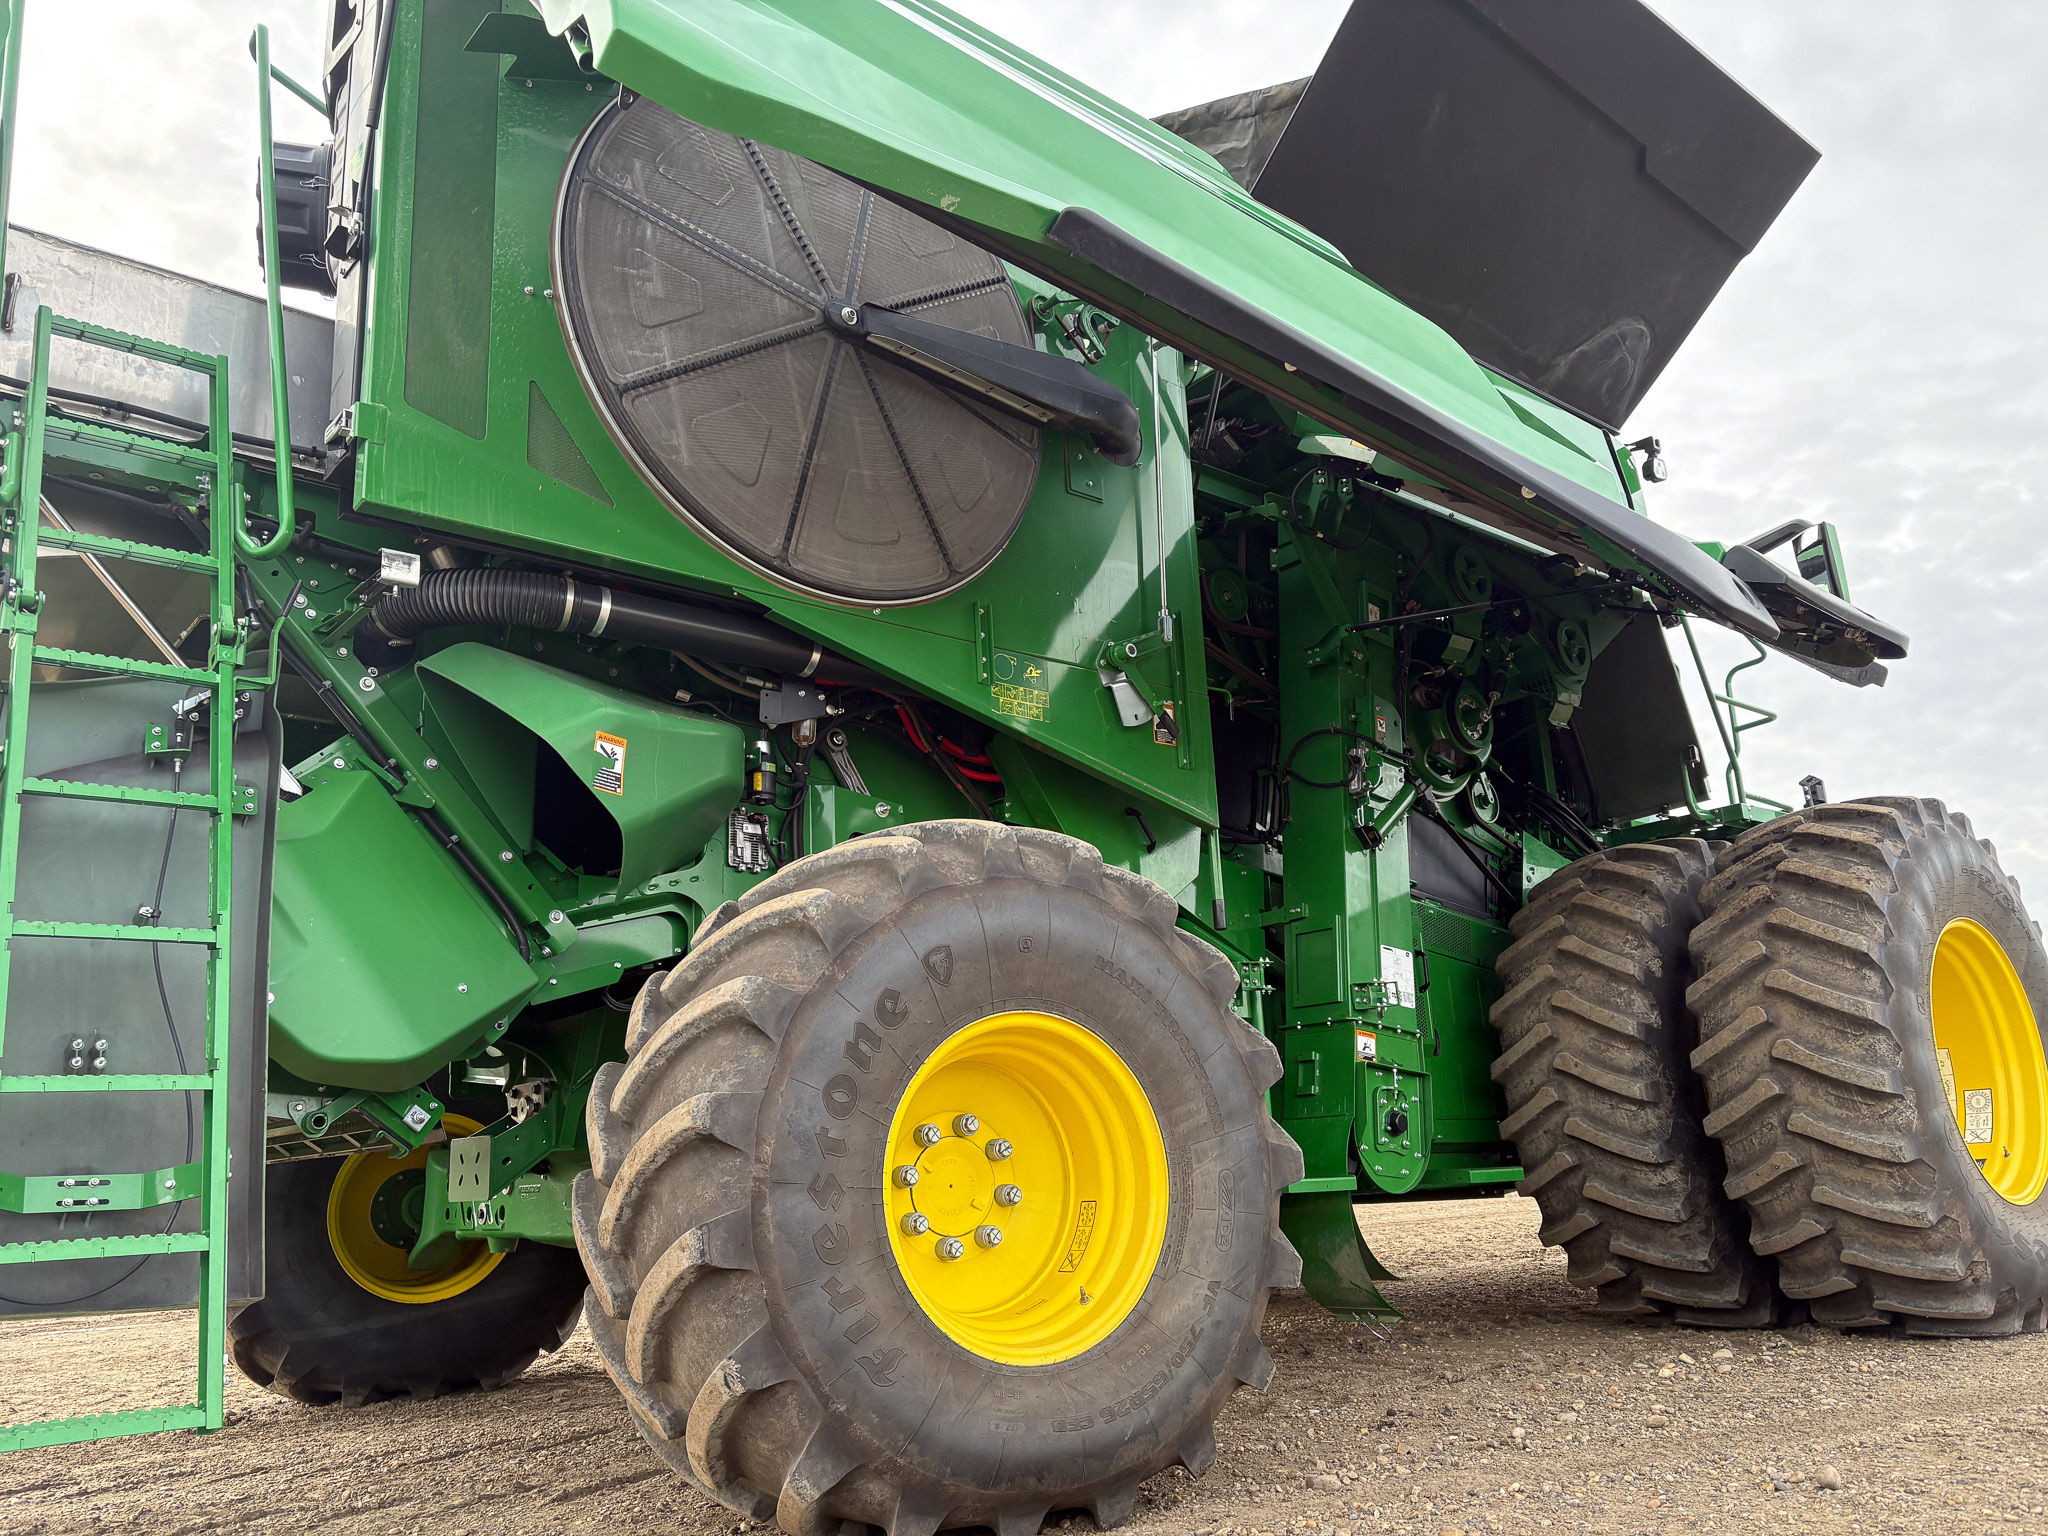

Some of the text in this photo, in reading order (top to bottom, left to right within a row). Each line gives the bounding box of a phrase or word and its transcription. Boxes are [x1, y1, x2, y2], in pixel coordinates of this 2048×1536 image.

[1093, 955, 1225, 1134] MAXI TRACTION
[807, 986, 909, 1388] Firestone
[1203, 1281, 1222, 1317] VF
[1100, 1325, 1204, 1425] 750/65R26
[1120, 1360, 1133, 1373] 43
[1051, 1415, 1095, 1433] CFO
